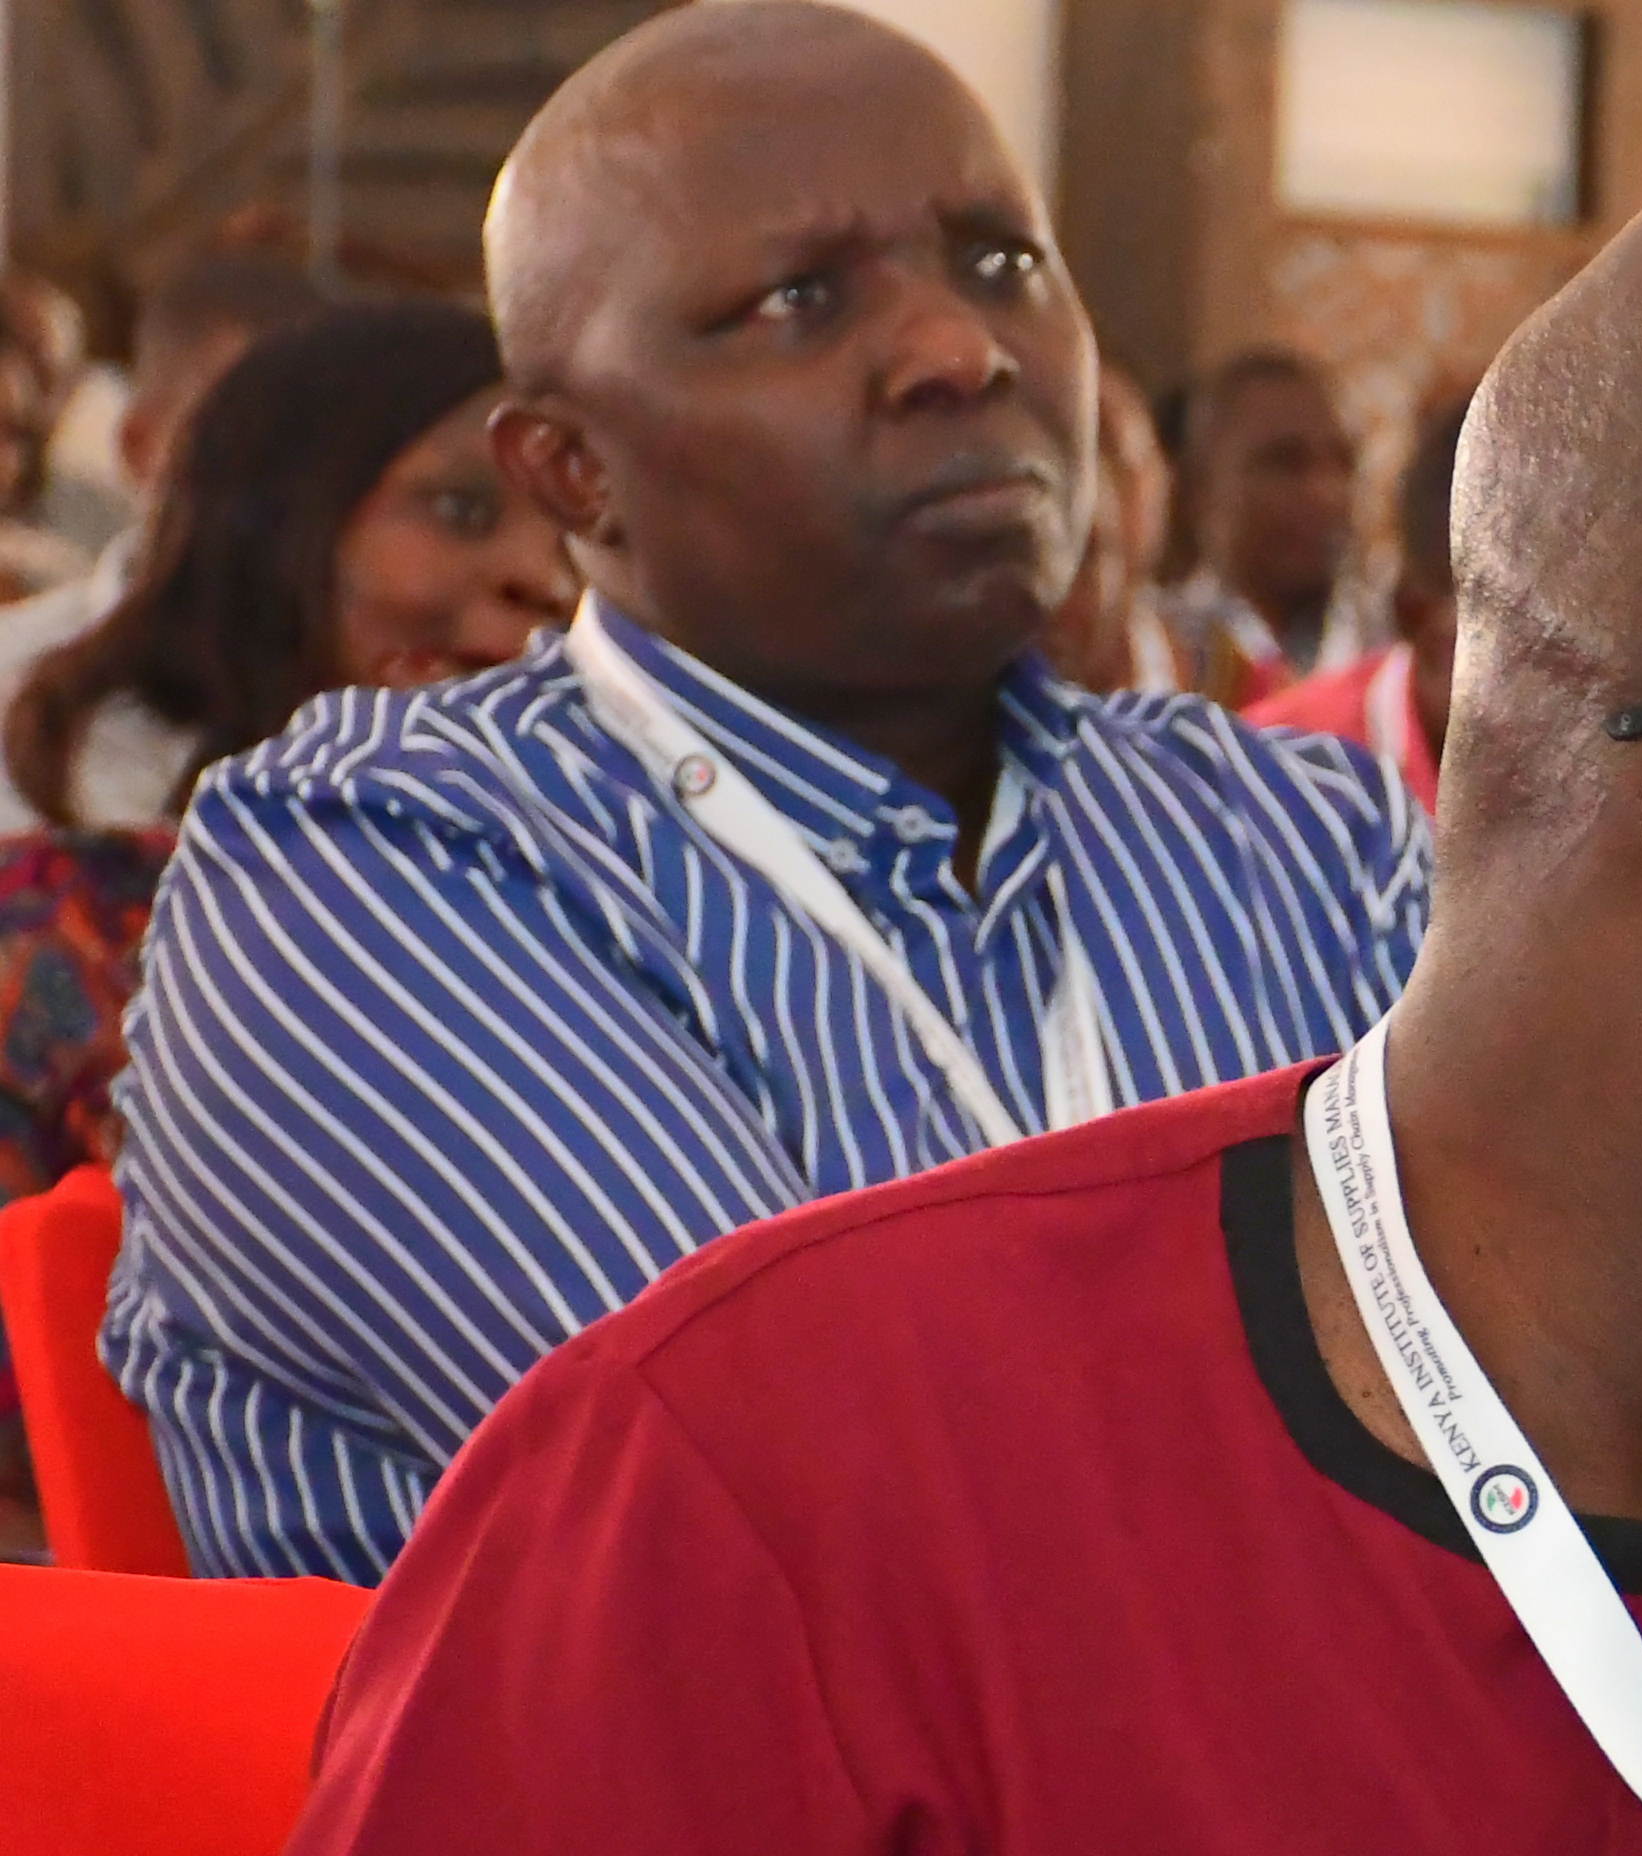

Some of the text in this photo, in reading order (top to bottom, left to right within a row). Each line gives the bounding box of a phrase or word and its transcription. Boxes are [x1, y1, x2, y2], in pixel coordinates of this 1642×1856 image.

[1350, 1109, 1365, 1151] Chain
[1329, 1135, 1369, 1239] SUPPLIES
[1358, 1152, 1377, 1200] Supply
[1360, 1243, 1378, 1272] OF
[1374, 1219, 1419, 1327] Professionalism
[1371, 1272, 1433, 1393] INSTITUTE
[1416, 1326, 1464, 1401] Promoting
[1427, 1390, 1482, 1474] KENYA
